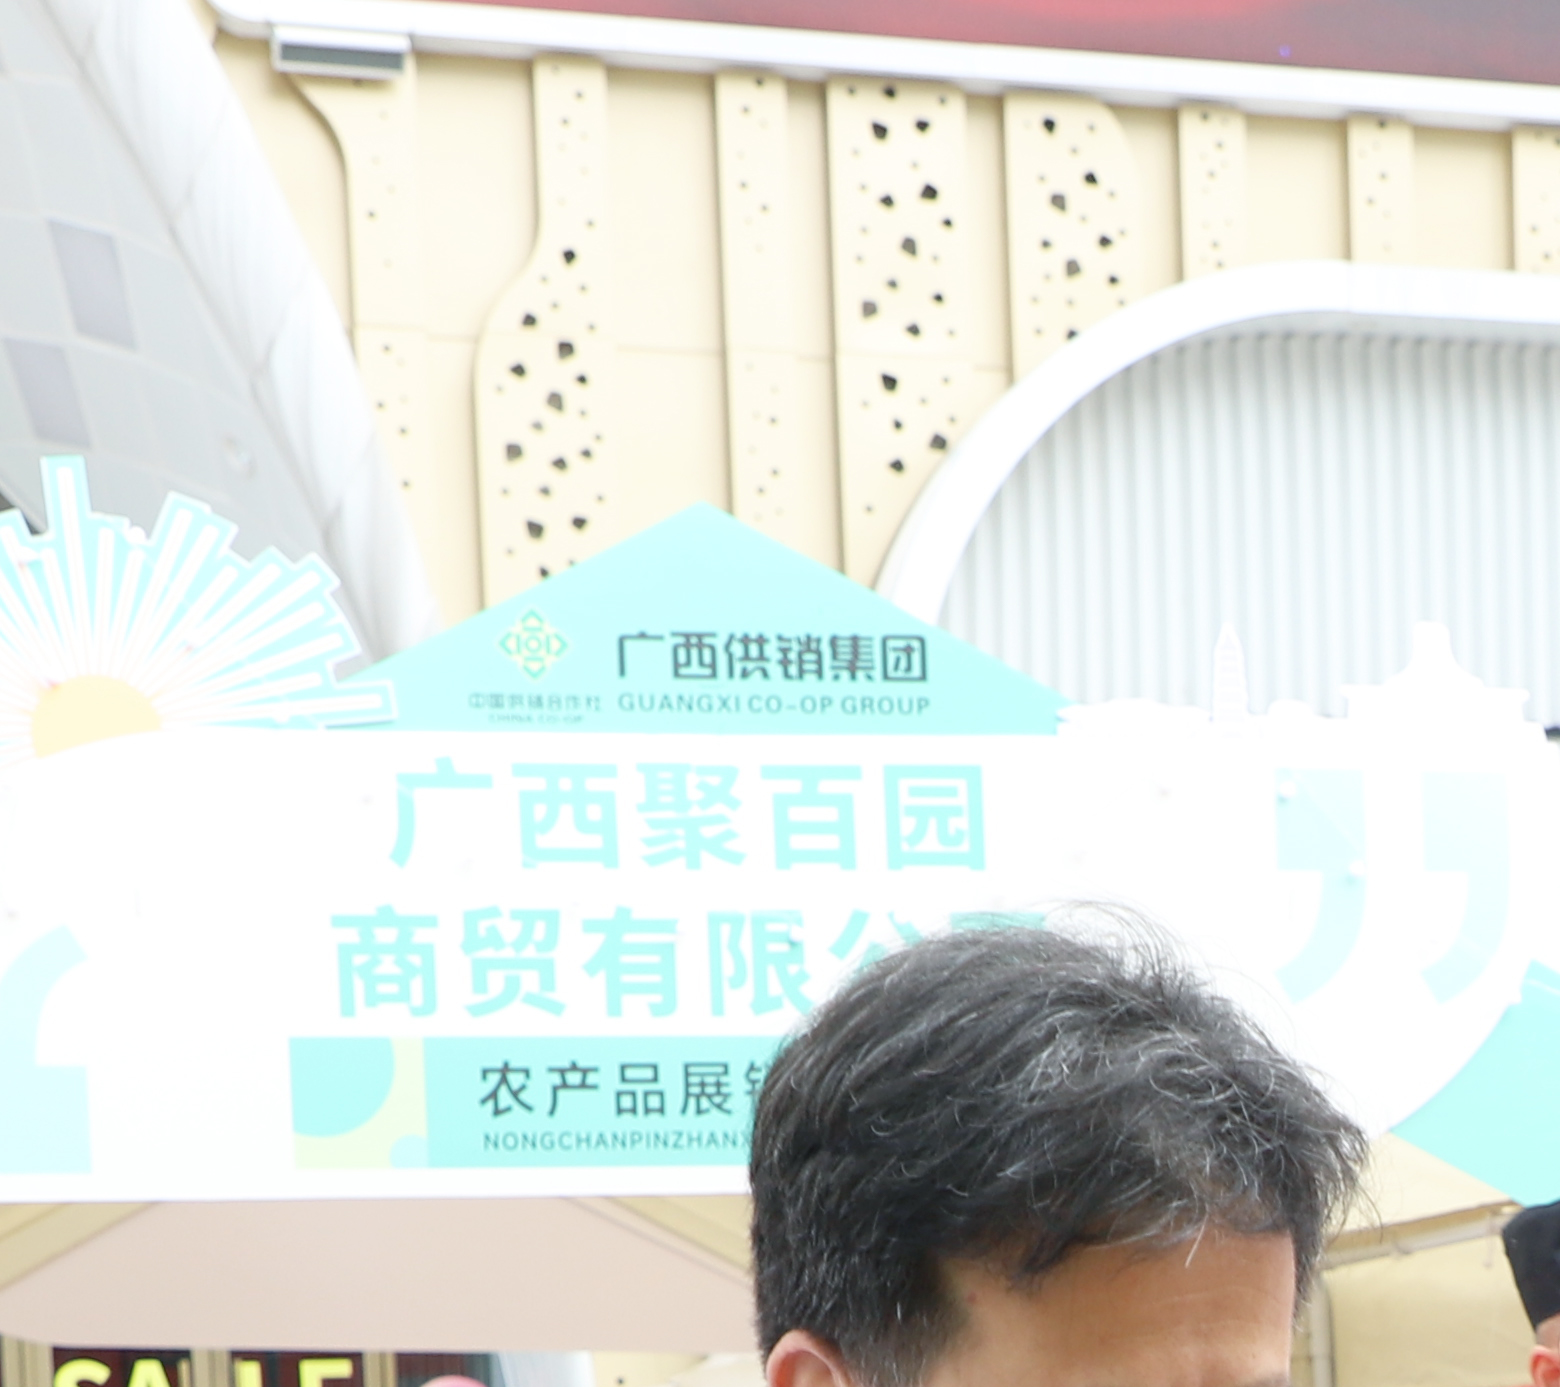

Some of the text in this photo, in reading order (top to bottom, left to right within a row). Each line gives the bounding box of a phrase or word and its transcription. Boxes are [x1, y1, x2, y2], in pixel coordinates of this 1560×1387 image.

[616, 629, 929, 684] 广西供销集团
[617, 692, 931, 716] GUANGXI CO-OP GROUP
[388, 755, 987, 872] 广西聚百园
